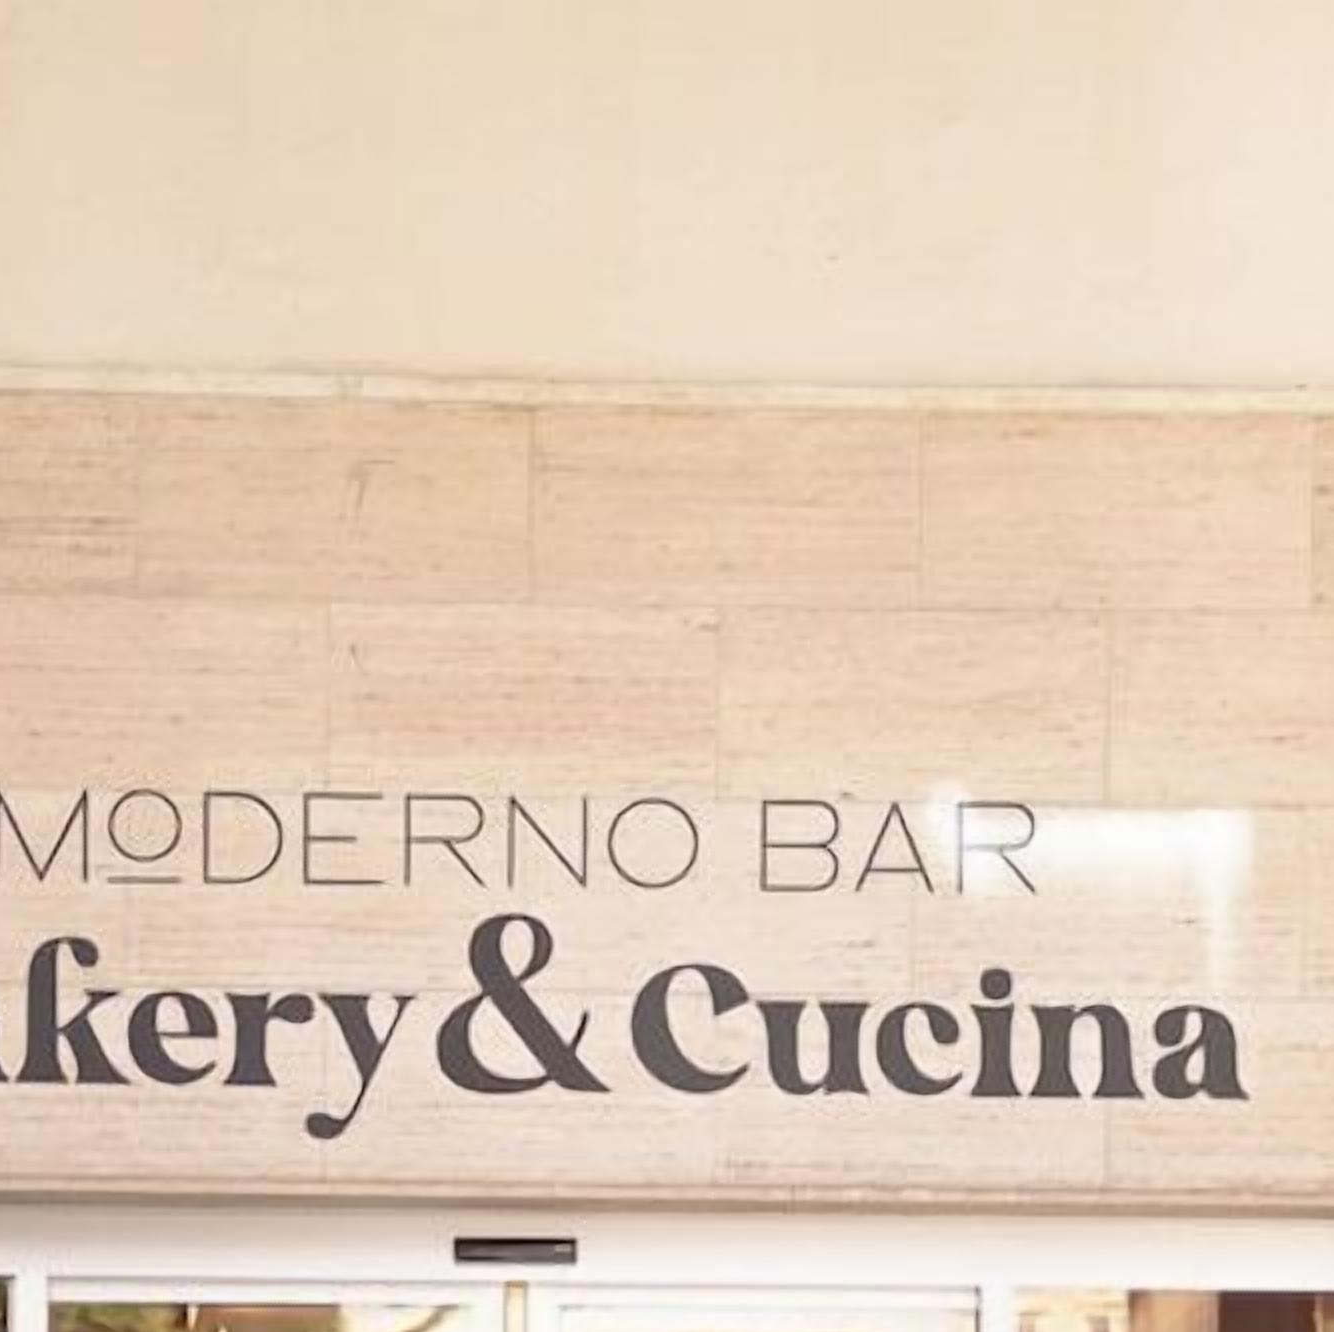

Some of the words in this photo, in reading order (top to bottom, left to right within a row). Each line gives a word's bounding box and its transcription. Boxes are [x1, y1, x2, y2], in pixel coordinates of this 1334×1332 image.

[759, 799, 1037, 893] BAR
[436, 913, 611, 1094] &
[631, 964, 1248, 1100] Cucina
